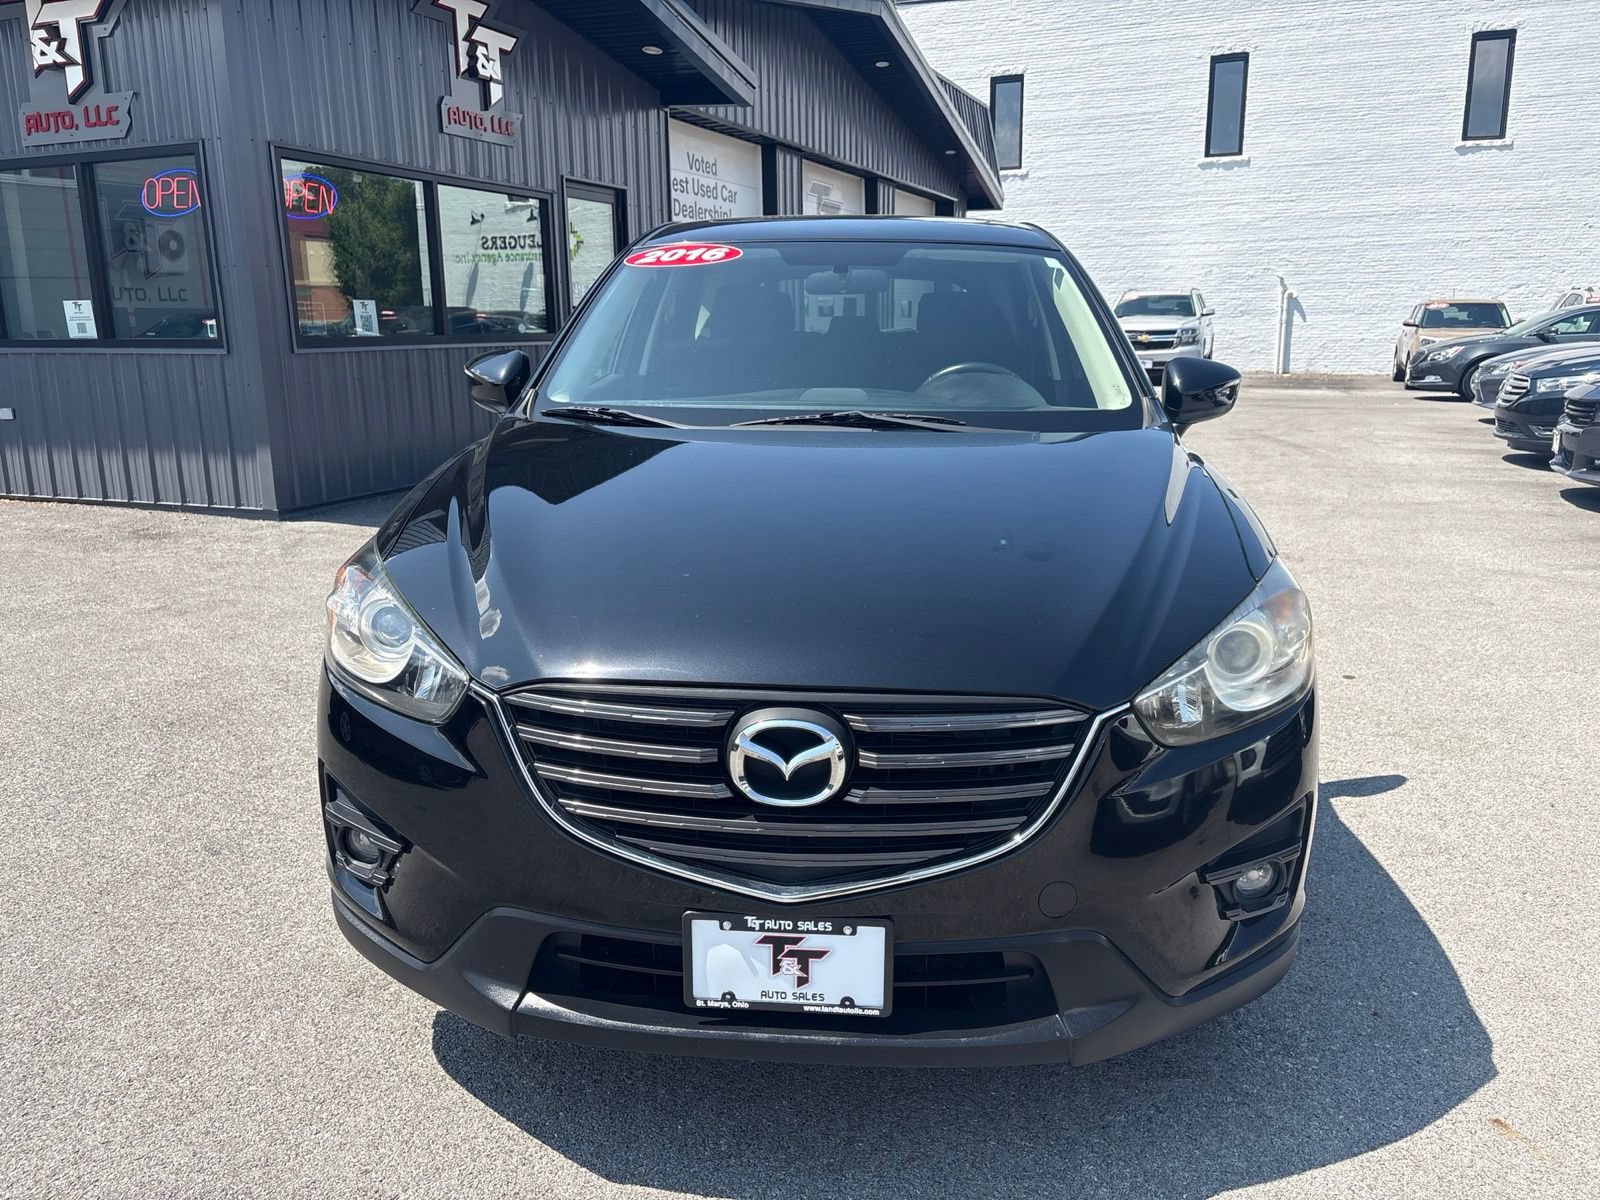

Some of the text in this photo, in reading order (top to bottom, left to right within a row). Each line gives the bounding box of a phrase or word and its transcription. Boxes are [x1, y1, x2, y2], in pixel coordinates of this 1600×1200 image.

[25, 105, 120, 136] AUTO, LLC
[447, 106, 514, 137] AUTO, LLC
[686, 152, 717, 176] Voted
[672, 177, 738, 204] est Used Car
[634, 248, 730, 264] 2016
[112, 286, 151, 303] UTO,
[765, 919, 793, 930] AUTO
[797, 921, 832, 931] SALES
[754, 933, 832, 990] T&T
[760, 990, 825, 1001] AUTO SALES
